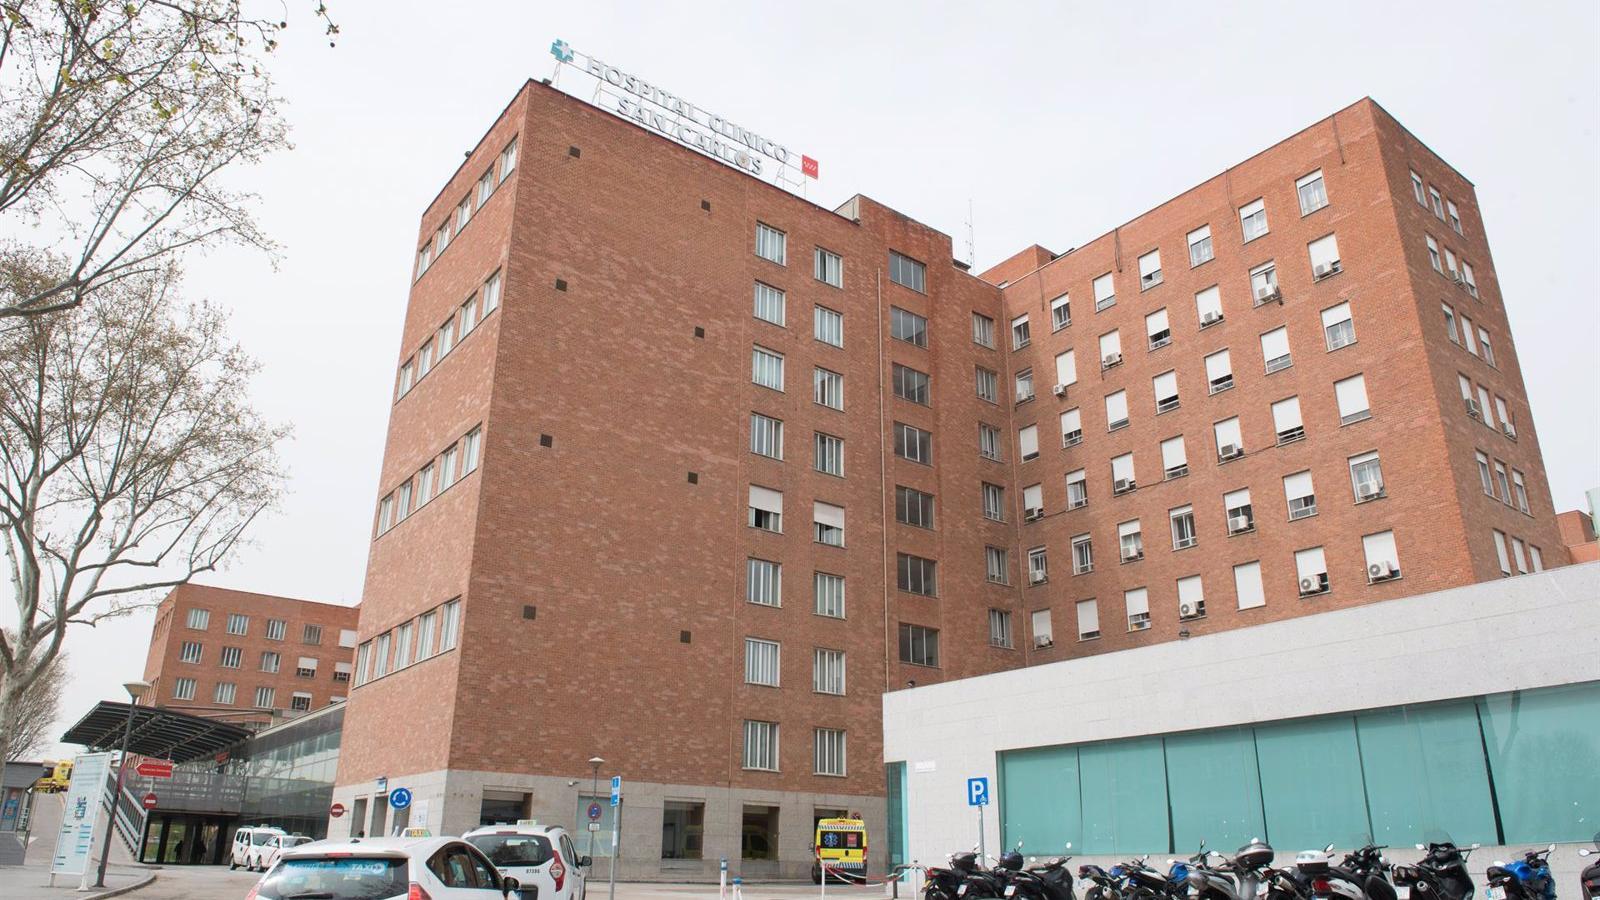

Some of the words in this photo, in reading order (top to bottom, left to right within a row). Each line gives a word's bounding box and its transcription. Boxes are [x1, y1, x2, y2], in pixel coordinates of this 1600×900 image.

[586, 56, 698, 123] HOSPITAL
[709, 113, 790, 163] CLINICO
[617, 96, 667, 133] SAN
[677, 123, 764, 176] CARLOS
[971, 780, 984, 803] P
